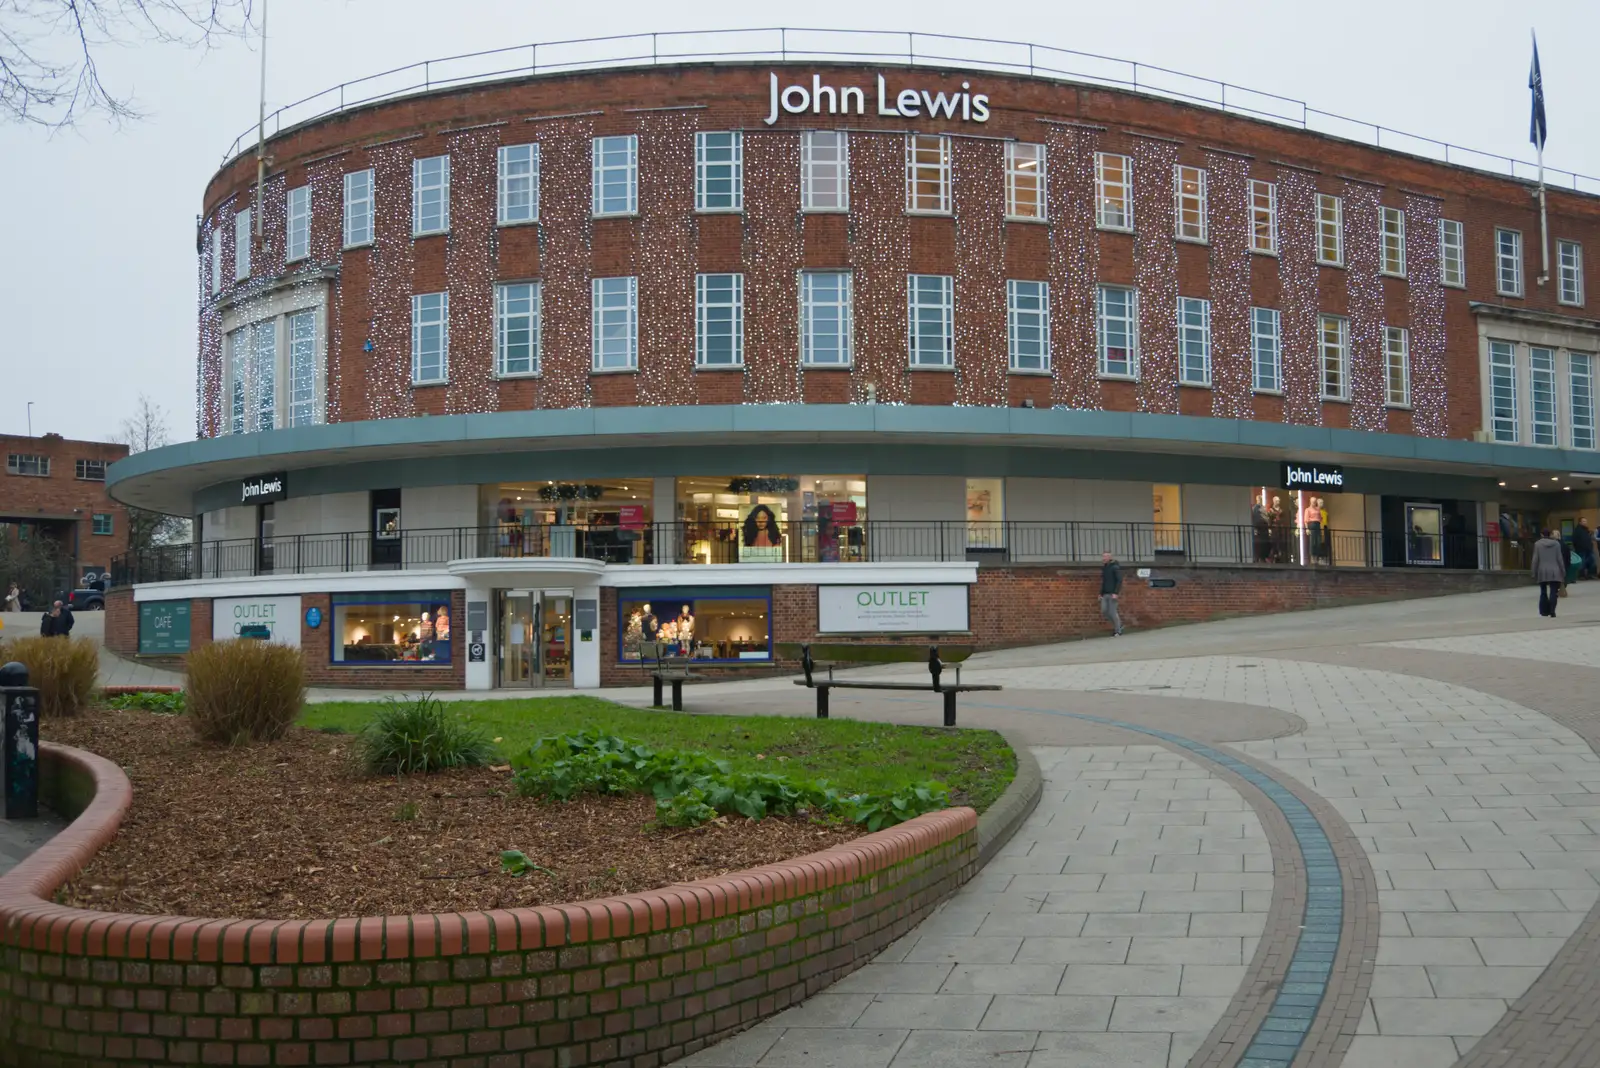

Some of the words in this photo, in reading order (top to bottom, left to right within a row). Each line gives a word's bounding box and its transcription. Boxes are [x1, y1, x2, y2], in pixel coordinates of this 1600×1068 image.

[764, 72, 864, 125] John
[878, 73, 990, 122] Lewis
[1286, 465, 1312, 486] John
[1313, 467, 1343, 486] Lewis
[241, 482, 260, 502] John
[260, 477, 282, 495] Lewis
[857, 591, 930, 606] OUTLET
[234, 603, 276, 618] OUTLET
[154, 612, 173, 629] CAFÉ
